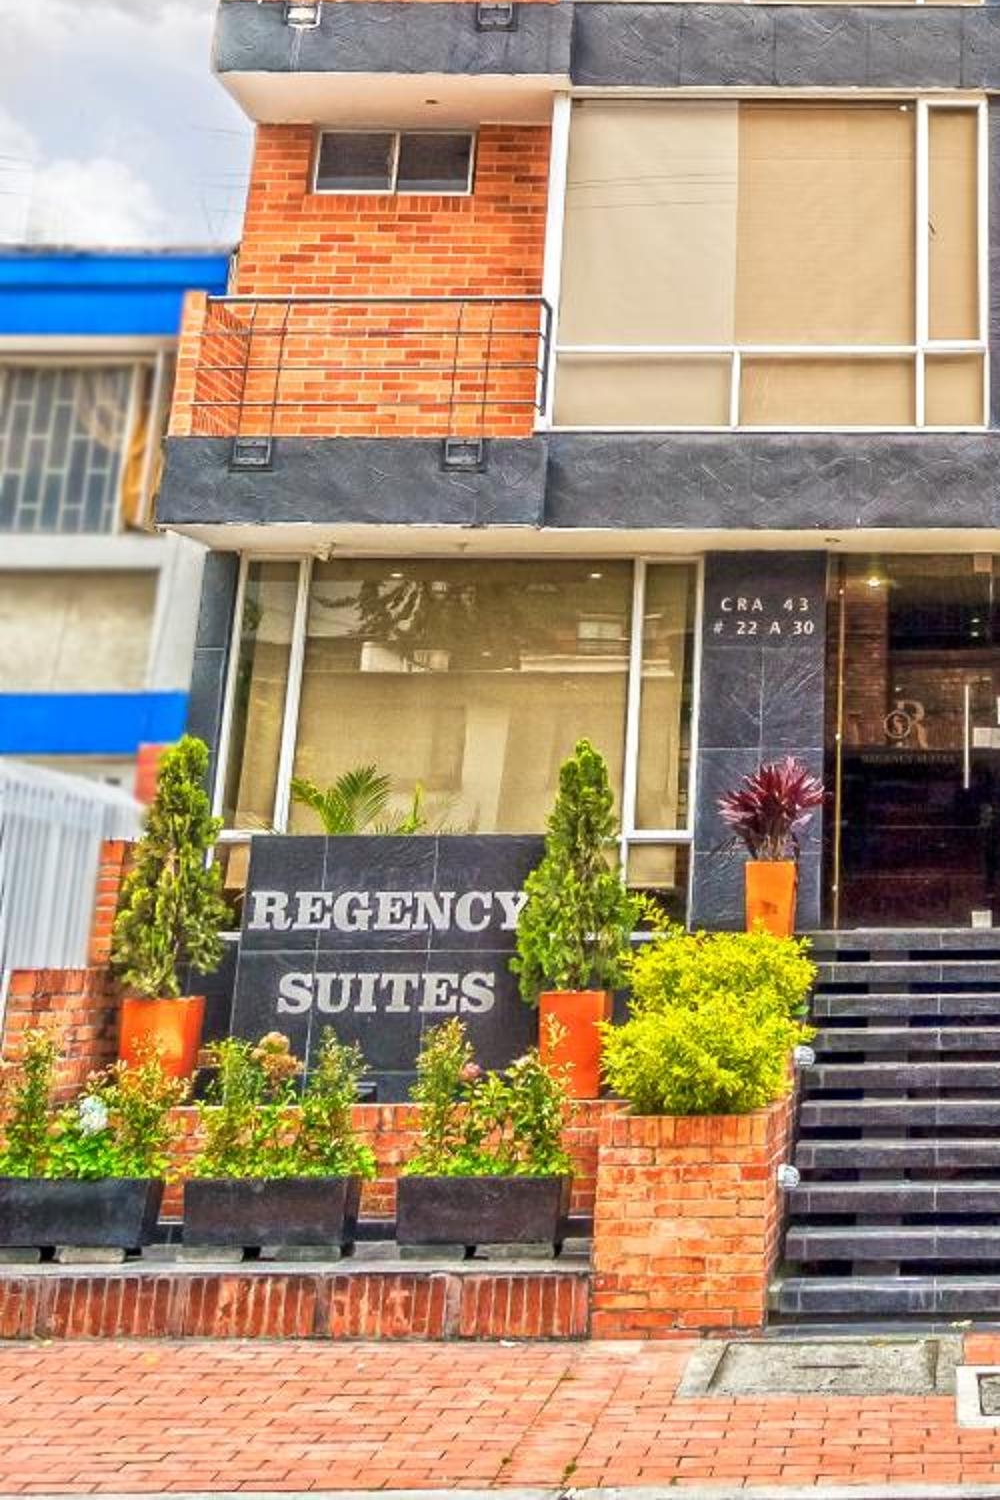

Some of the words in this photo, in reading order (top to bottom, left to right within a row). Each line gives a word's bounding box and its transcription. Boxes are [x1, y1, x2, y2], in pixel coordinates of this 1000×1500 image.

[721, 598, 763, 611] CRA
[783, 598, 809, 611] 43
[736, 621, 758, 635] 22
[769, 621, 781, 635] A
[793, 621, 815, 635] 30
[248, 890, 529, 932] REGENCY
[277, 971, 495, 1014] SUITES
